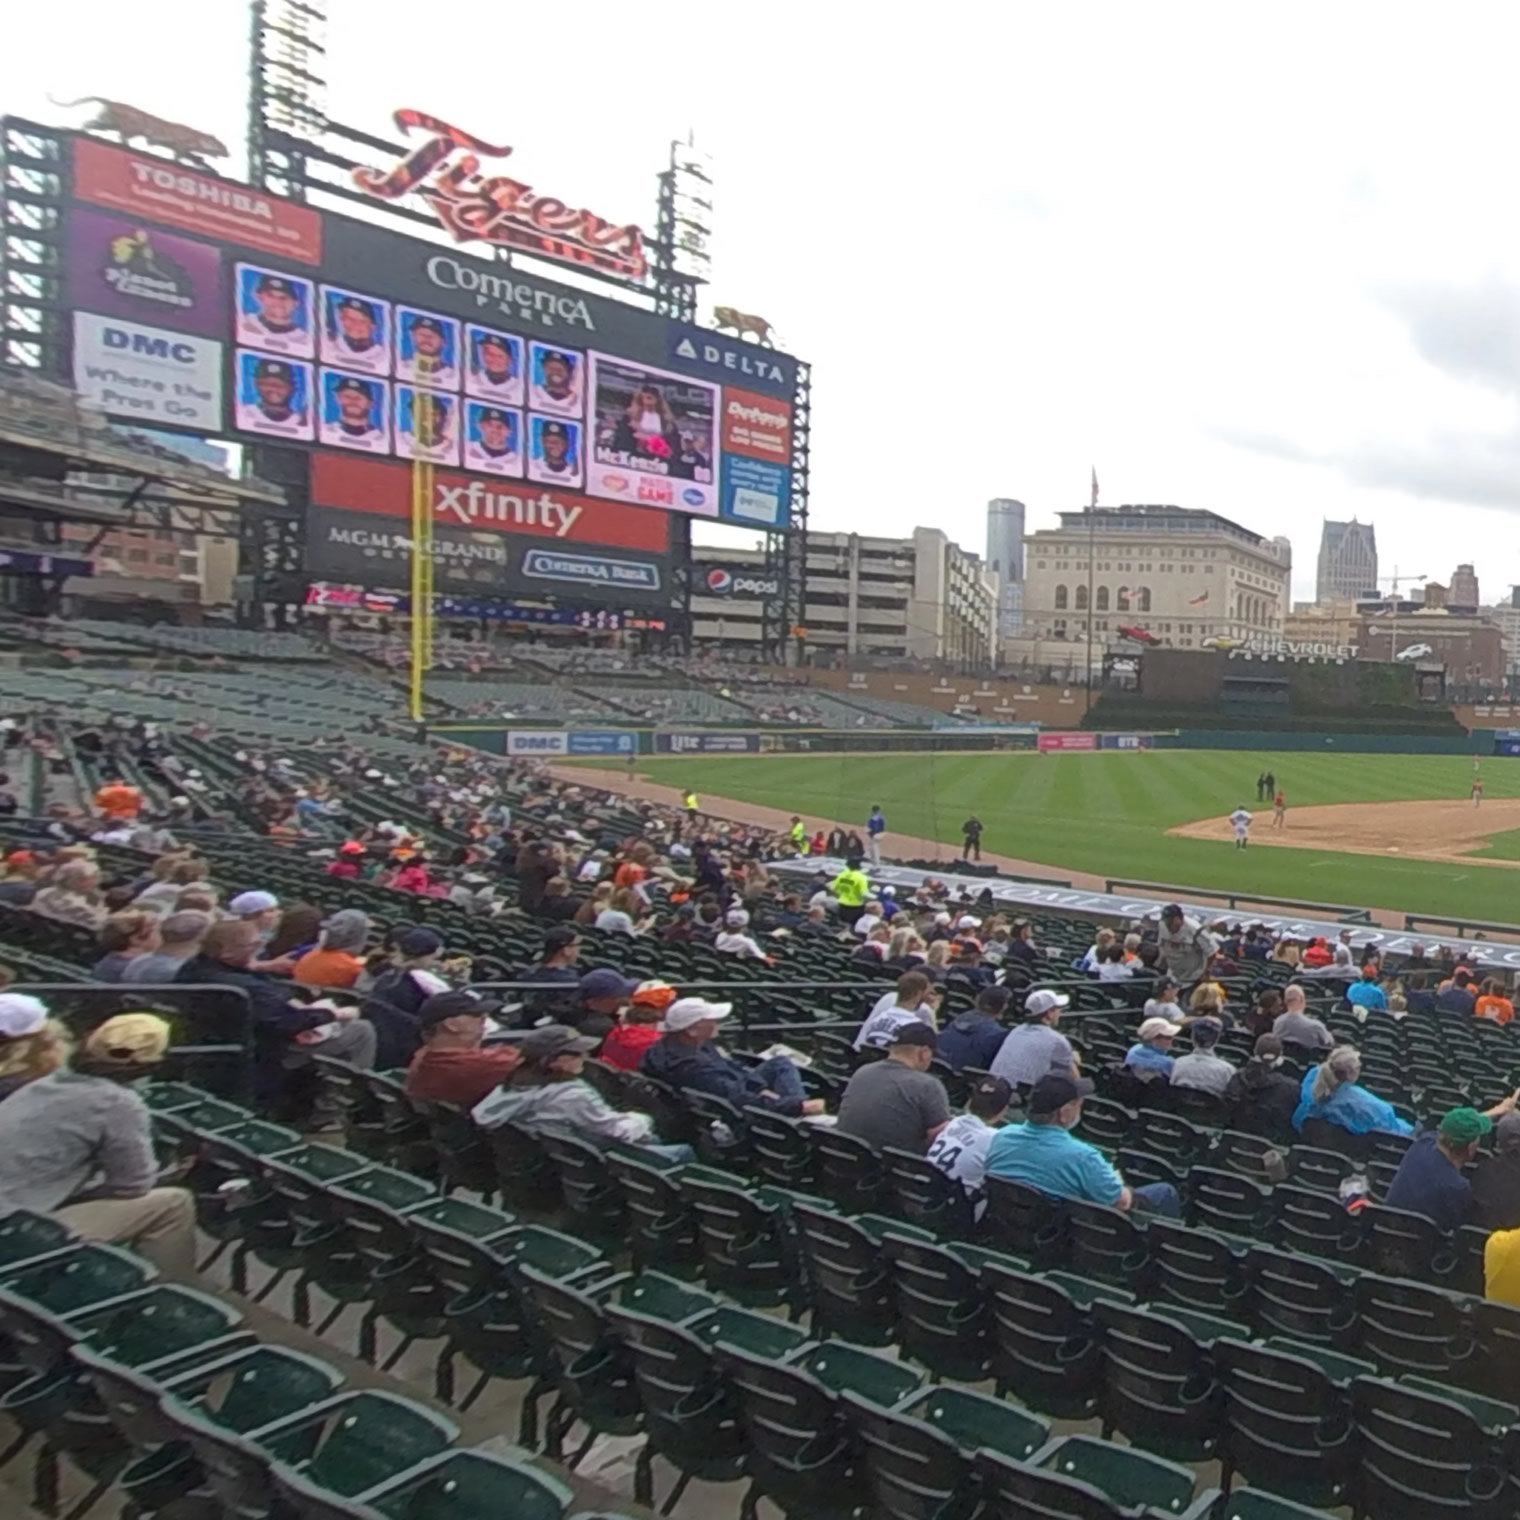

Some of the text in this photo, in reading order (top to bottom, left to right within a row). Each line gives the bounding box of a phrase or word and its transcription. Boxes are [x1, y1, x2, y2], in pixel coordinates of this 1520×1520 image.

[130, 161, 274, 219] TOSHIBA
[351, 108, 650, 280] Tigers
[475, 294, 554, 326] PARK
[103, 326, 198, 364] DMC
[704, 346, 784, 383] DELTA
[85, 365, 213, 401] Where the
[164, 400, 198, 418] Go
[435, 481, 583, 537] xfinity
[328, 526, 502, 562] MGM GRAND
[733, 577, 777, 595] pepsi
[1248, 640, 1360, 657] CHEVROLET
[513, 736, 562, 750] DMC
[928, 1139, 962, 1173] 24
